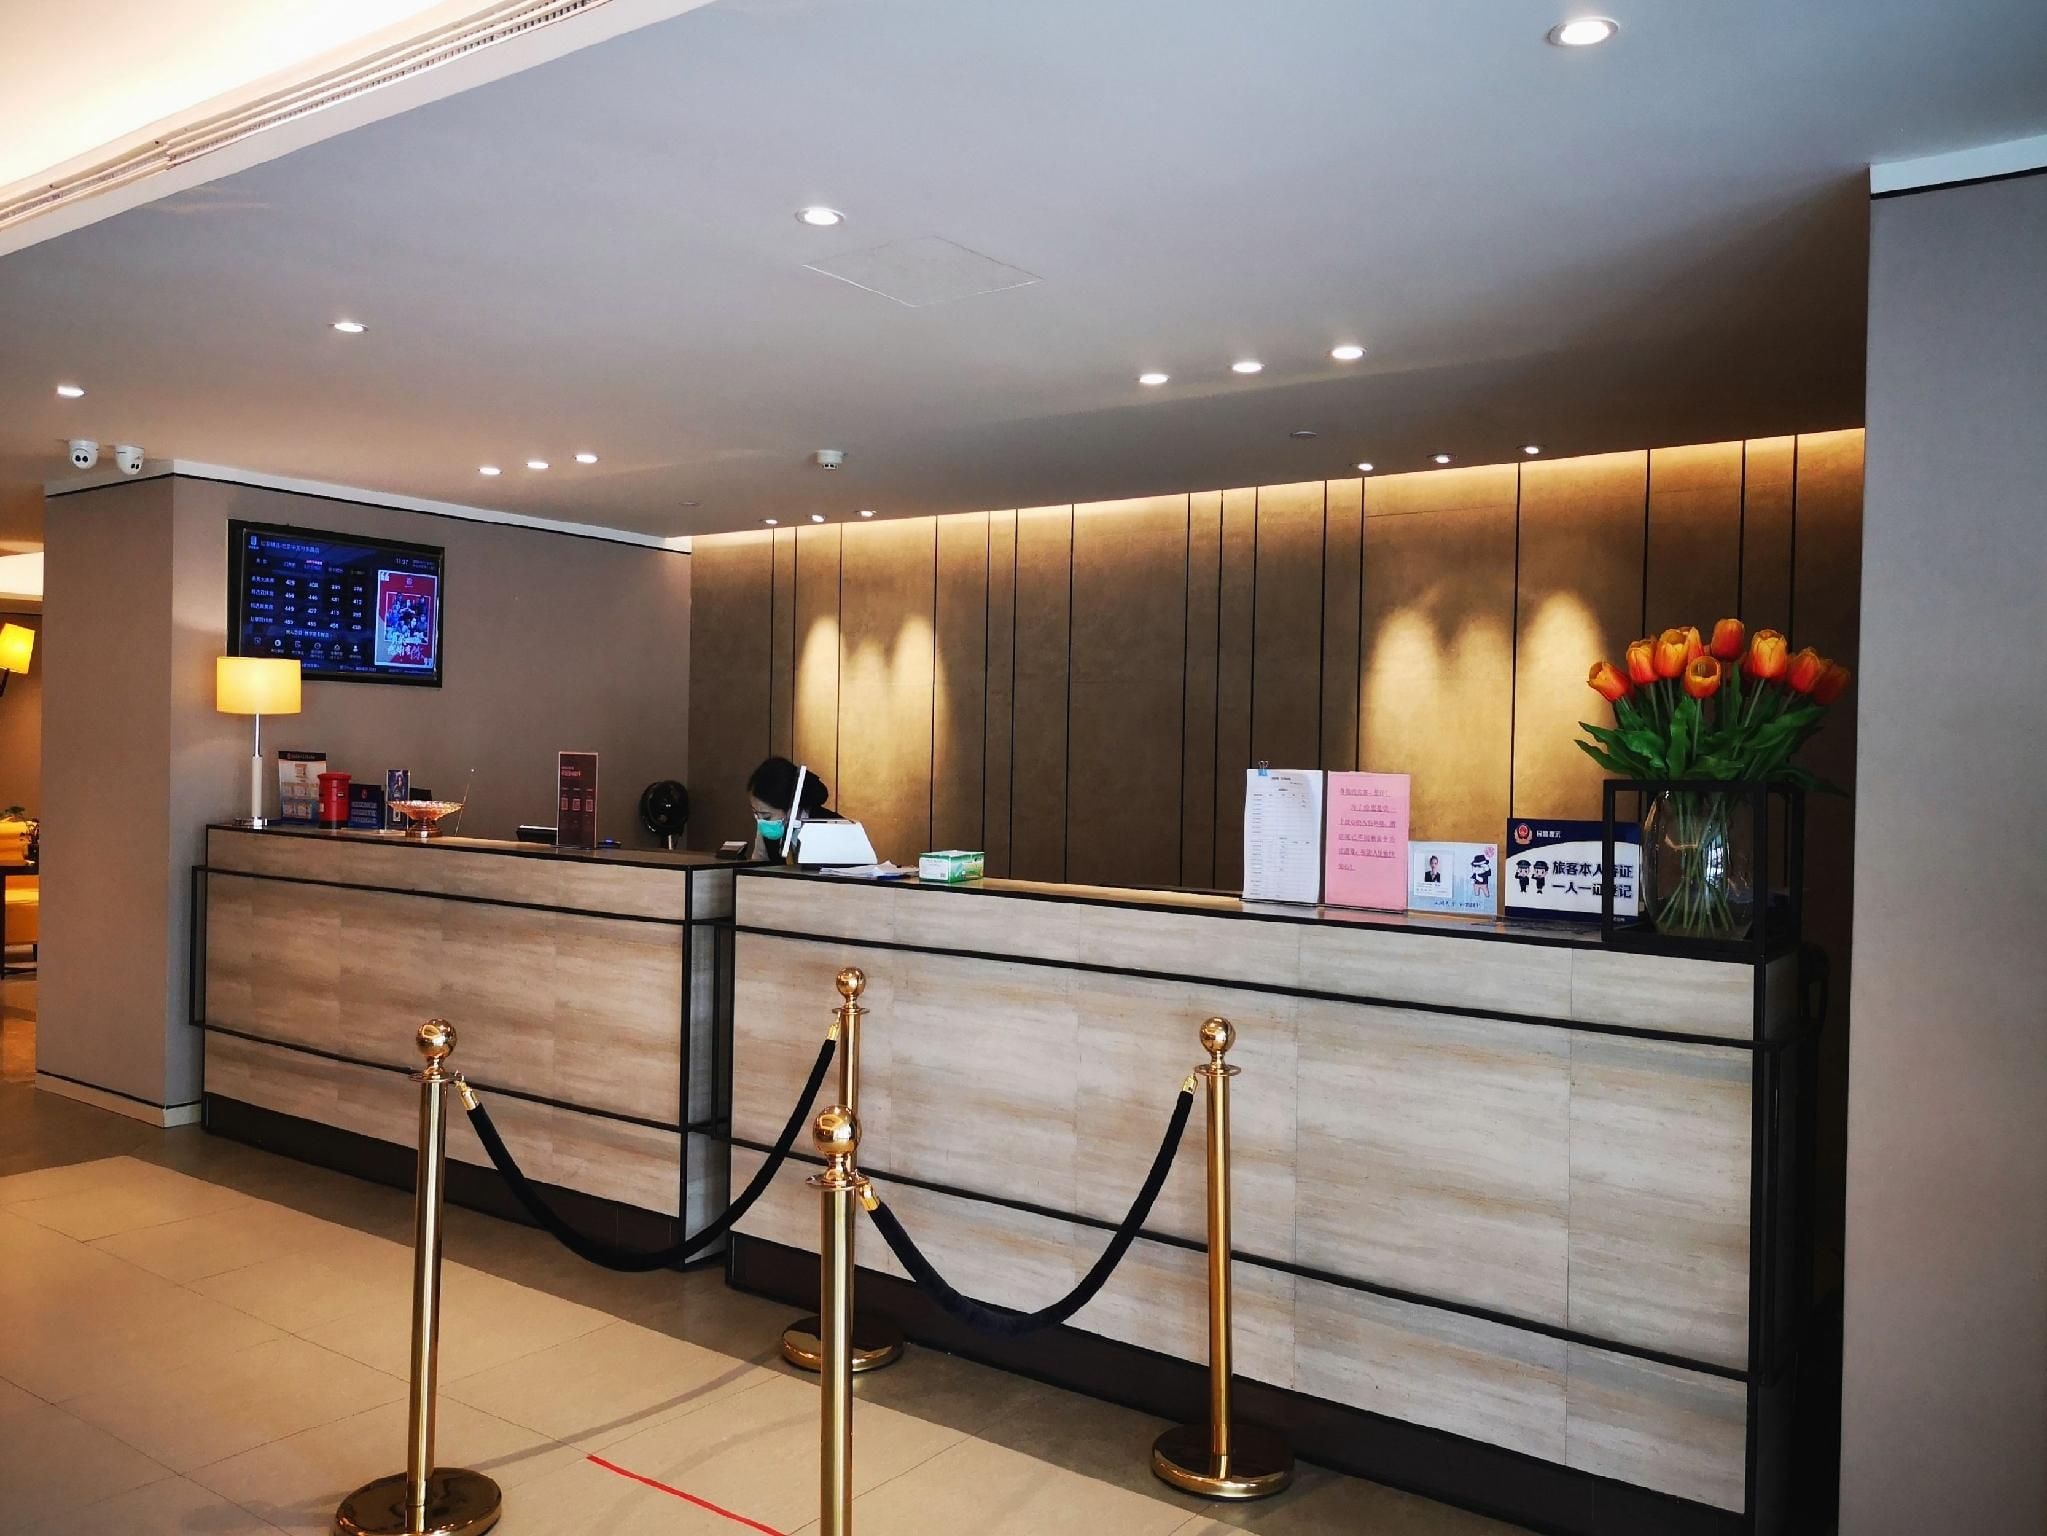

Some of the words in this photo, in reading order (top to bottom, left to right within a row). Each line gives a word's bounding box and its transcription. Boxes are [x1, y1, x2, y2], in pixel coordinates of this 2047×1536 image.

[1552, 860, 1634, 879] 旅客本人证
[1551, 881, 1633, 899] 一人一证记
